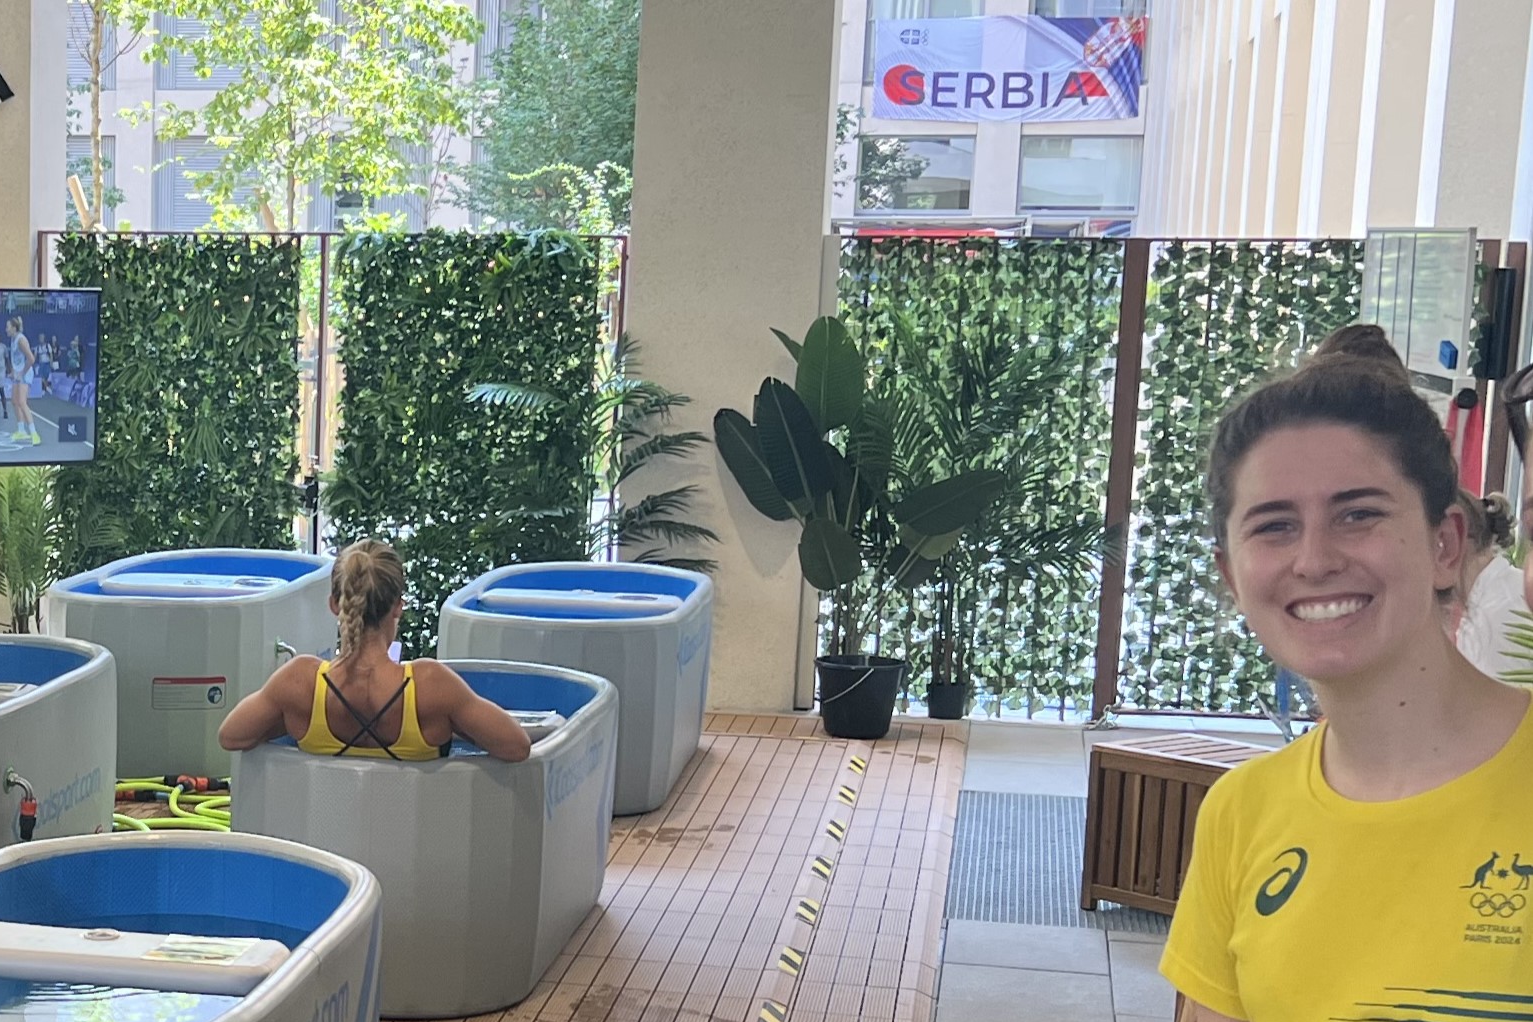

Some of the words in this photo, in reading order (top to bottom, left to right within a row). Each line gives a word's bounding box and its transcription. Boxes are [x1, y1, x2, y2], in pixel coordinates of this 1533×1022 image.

[898, 70, 1089, 109] SERBIA
[1465, 924, 1522, 934] AUSTRALIA
[1464, 934, 1492, 944] PARIS
[1494, 935, 1521, 945] 2024
